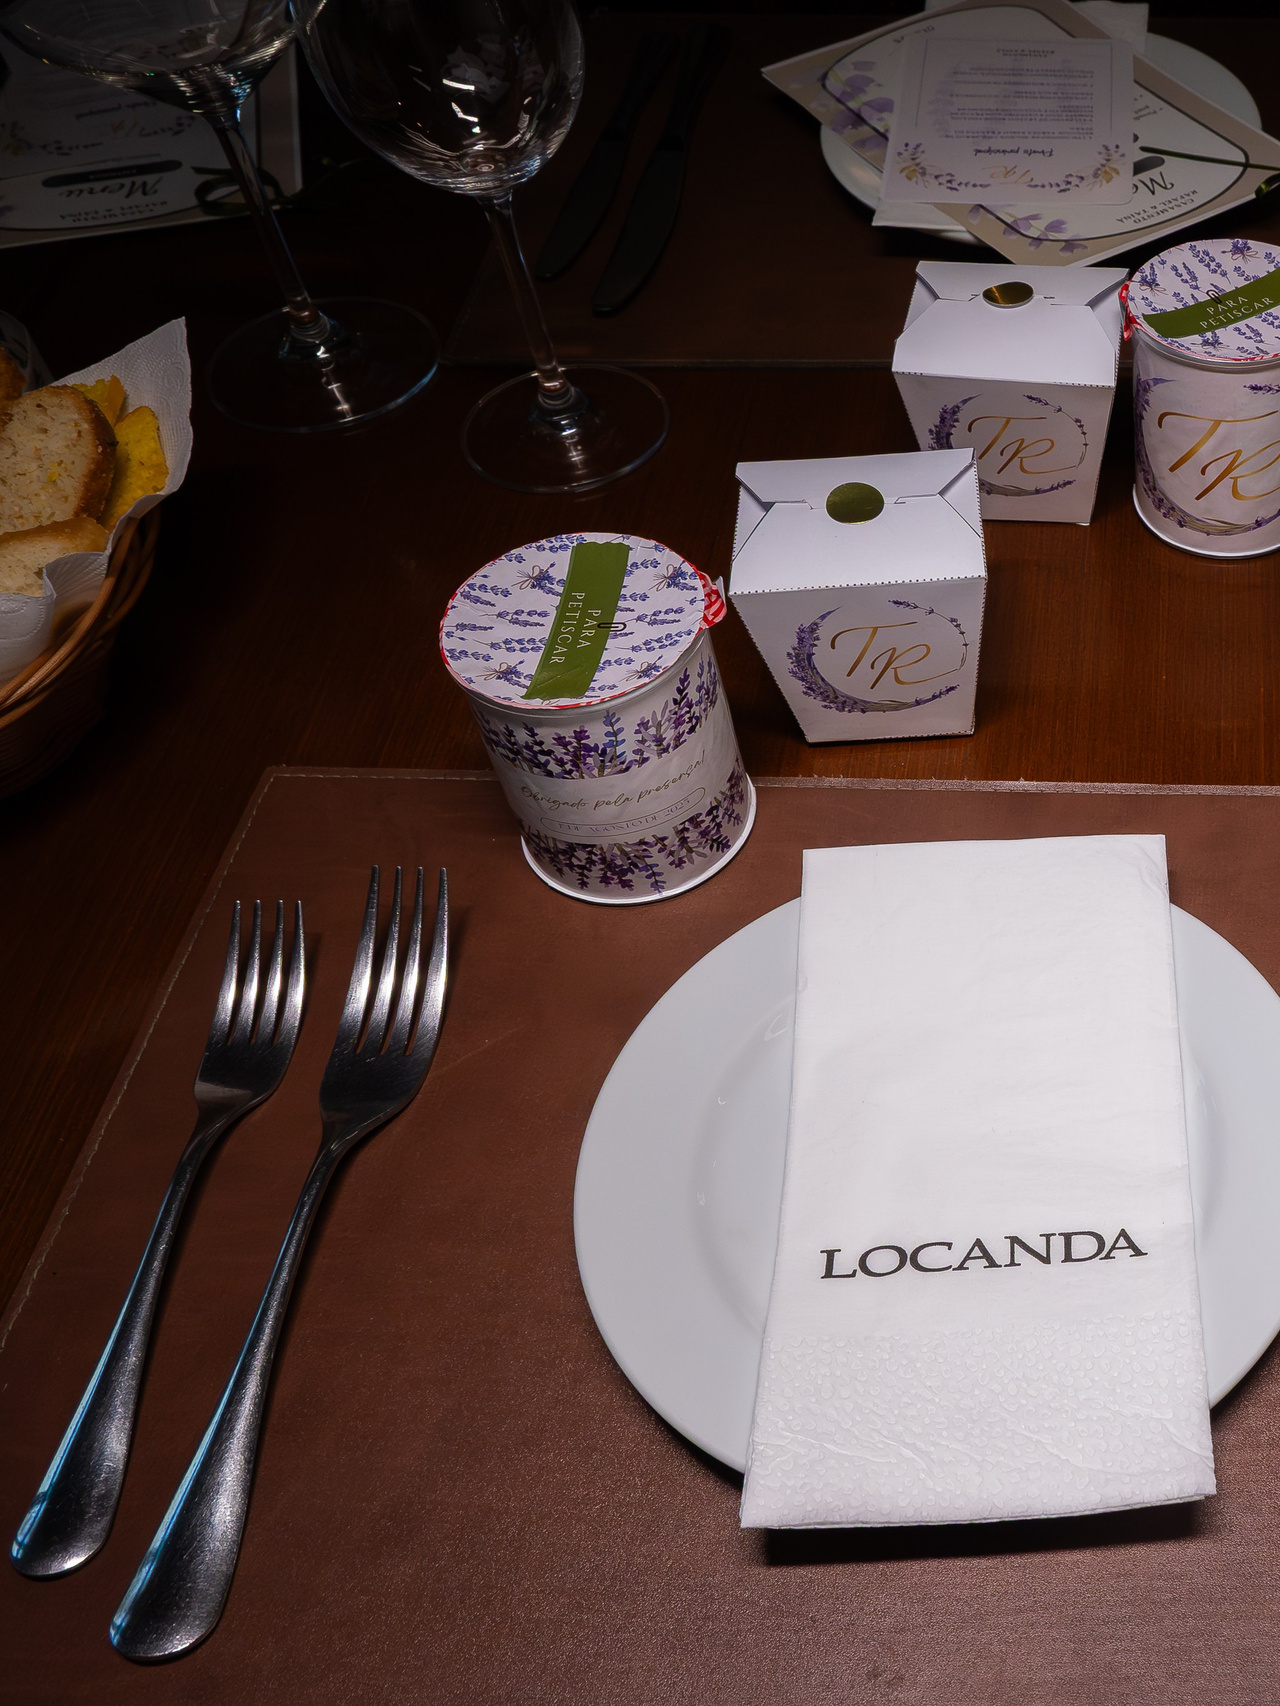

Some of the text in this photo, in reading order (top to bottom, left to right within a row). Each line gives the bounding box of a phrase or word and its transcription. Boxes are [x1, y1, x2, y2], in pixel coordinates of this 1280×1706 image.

[1199, 297, 1275, 329] PETISCAR
[1206, 296, 1249, 315] PARA
[549, 592, 586, 664] PETISCAR
[576, 609, 602, 649] PARA
[520, 785, 590, 811] Obrigado
[593, 792, 634, 811] pela
[820, 1227, 1149, 1280] LOCANDA
